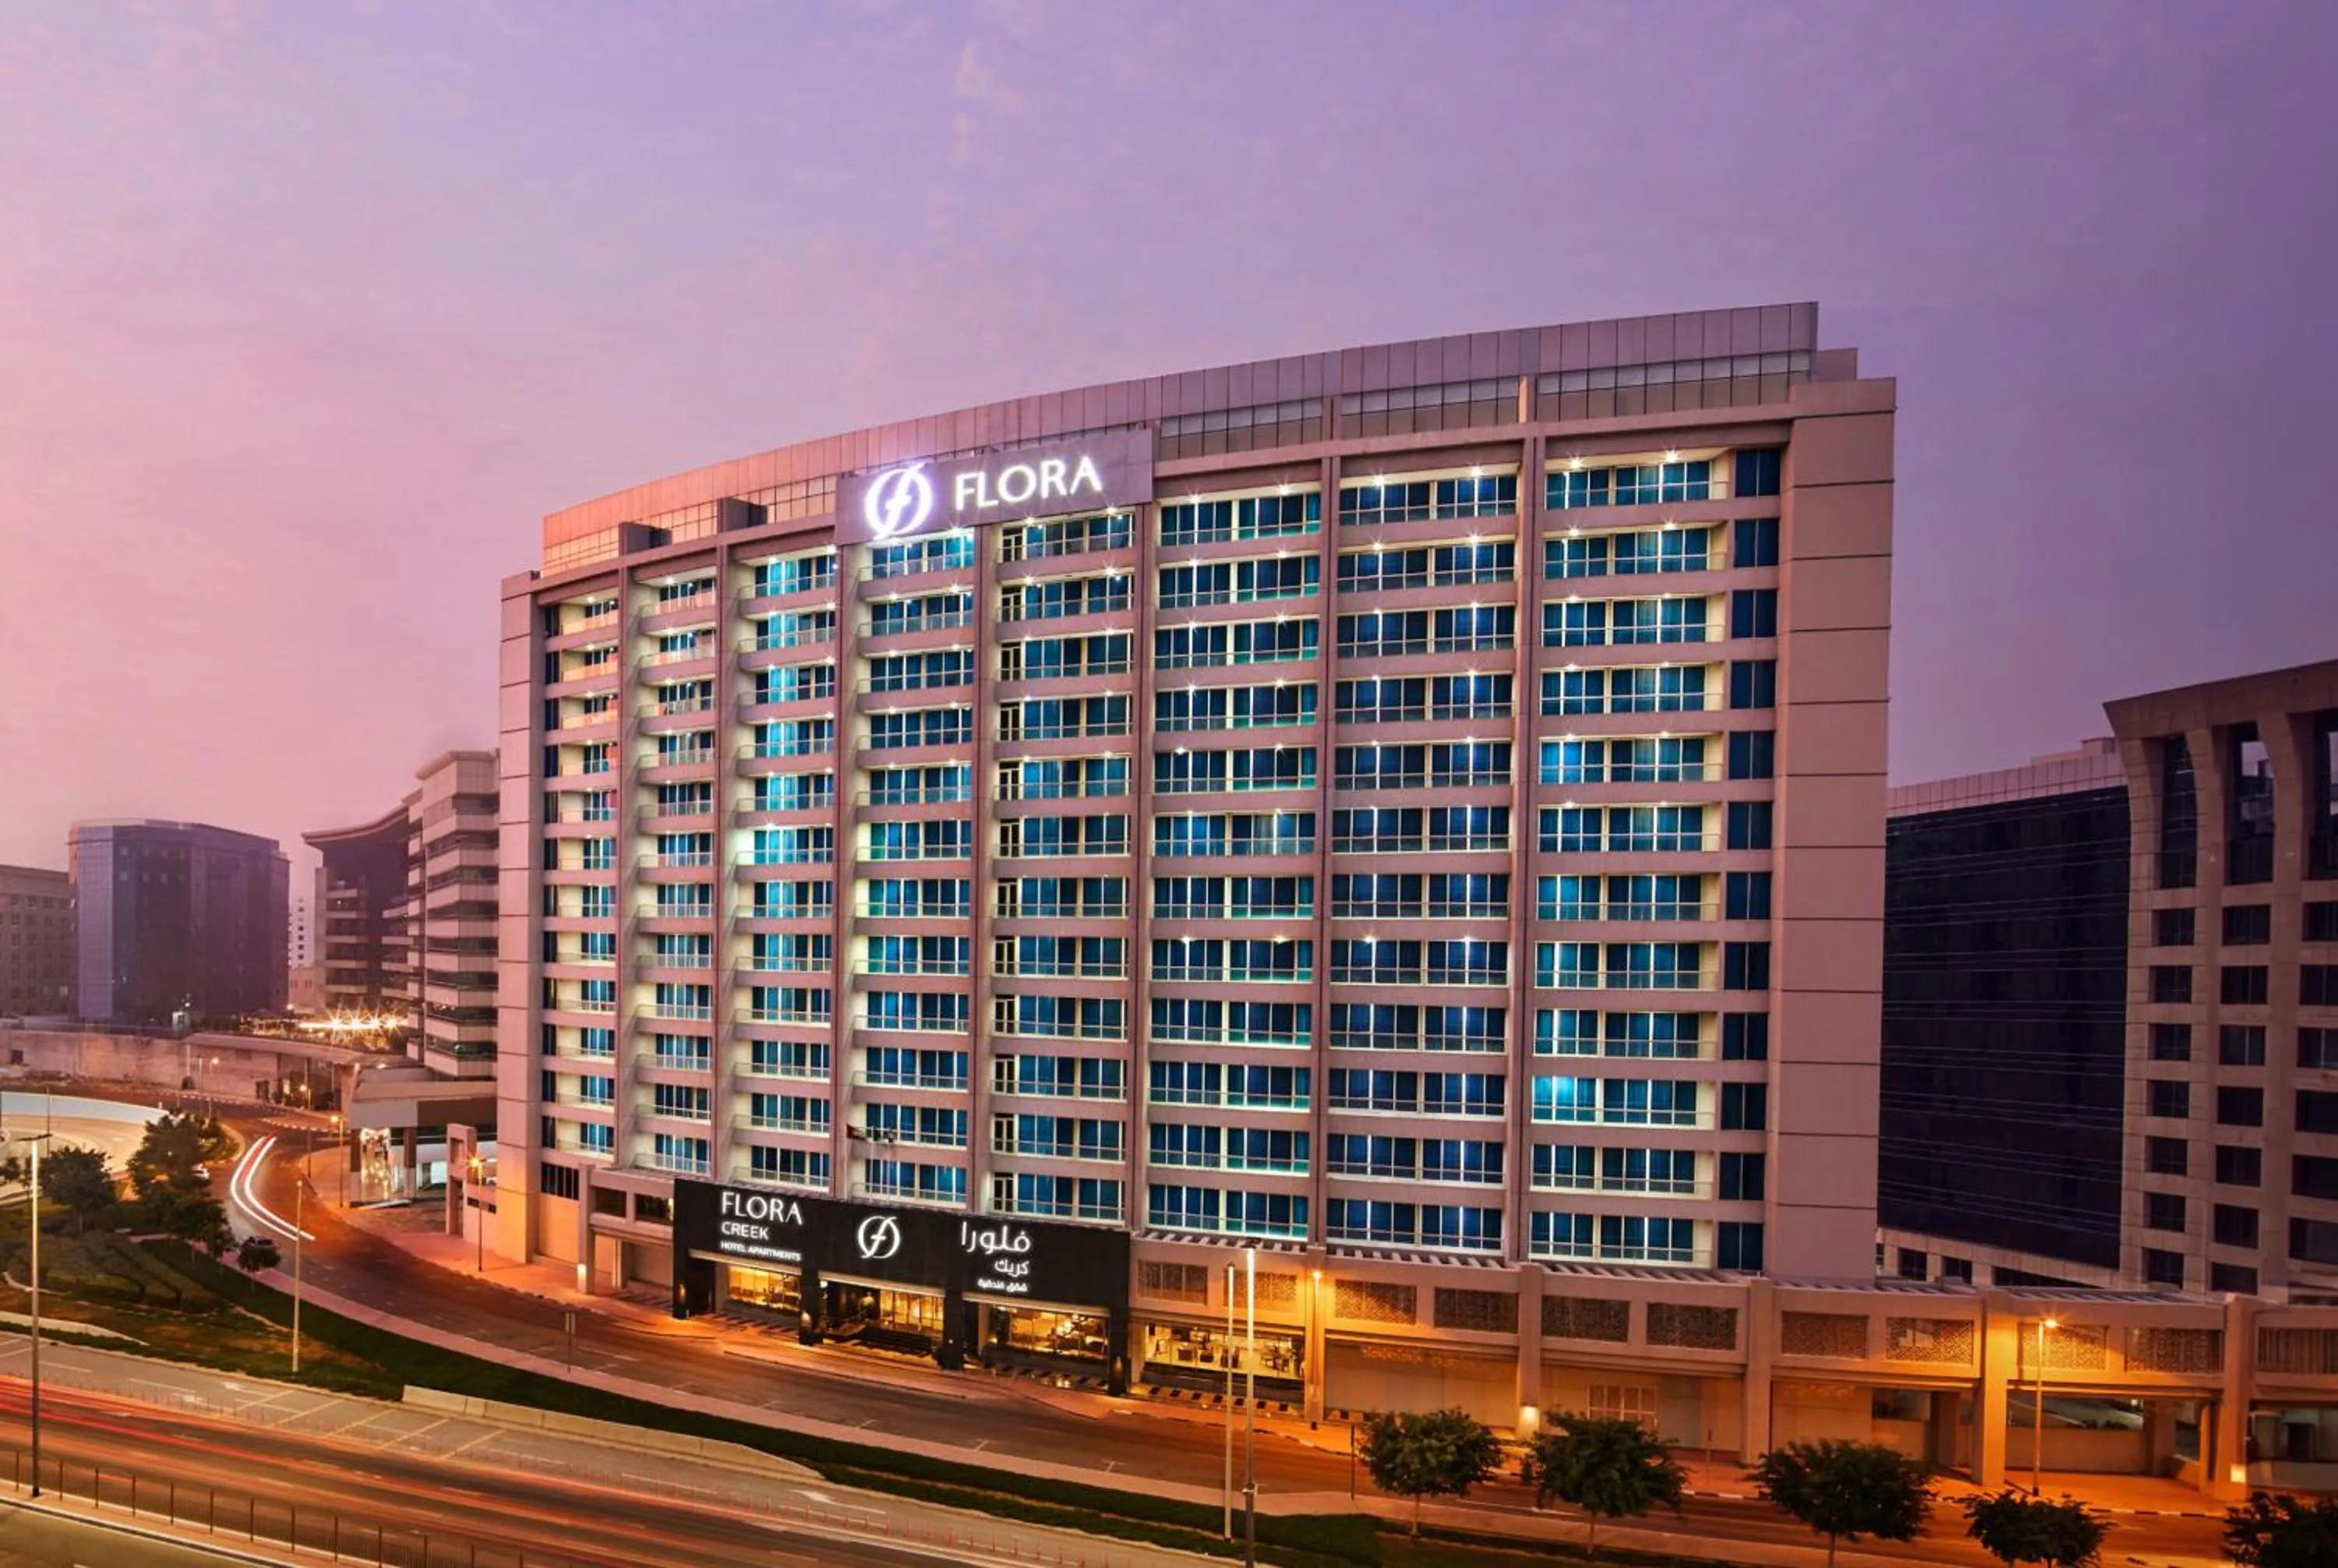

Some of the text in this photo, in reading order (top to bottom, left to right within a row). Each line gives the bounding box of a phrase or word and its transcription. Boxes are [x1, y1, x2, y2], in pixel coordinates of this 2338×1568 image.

[954, 455, 1103, 512] FLORA
[721, 1191, 803, 1226] FLORA
[720, 1220, 770, 1241] CREEK
[961, 1220, 1031, 1255] فلورا
[719, 1241, 802, 1262] HOTEL APARTMENTS
[994, 1259, 1029, 1278] كريك
